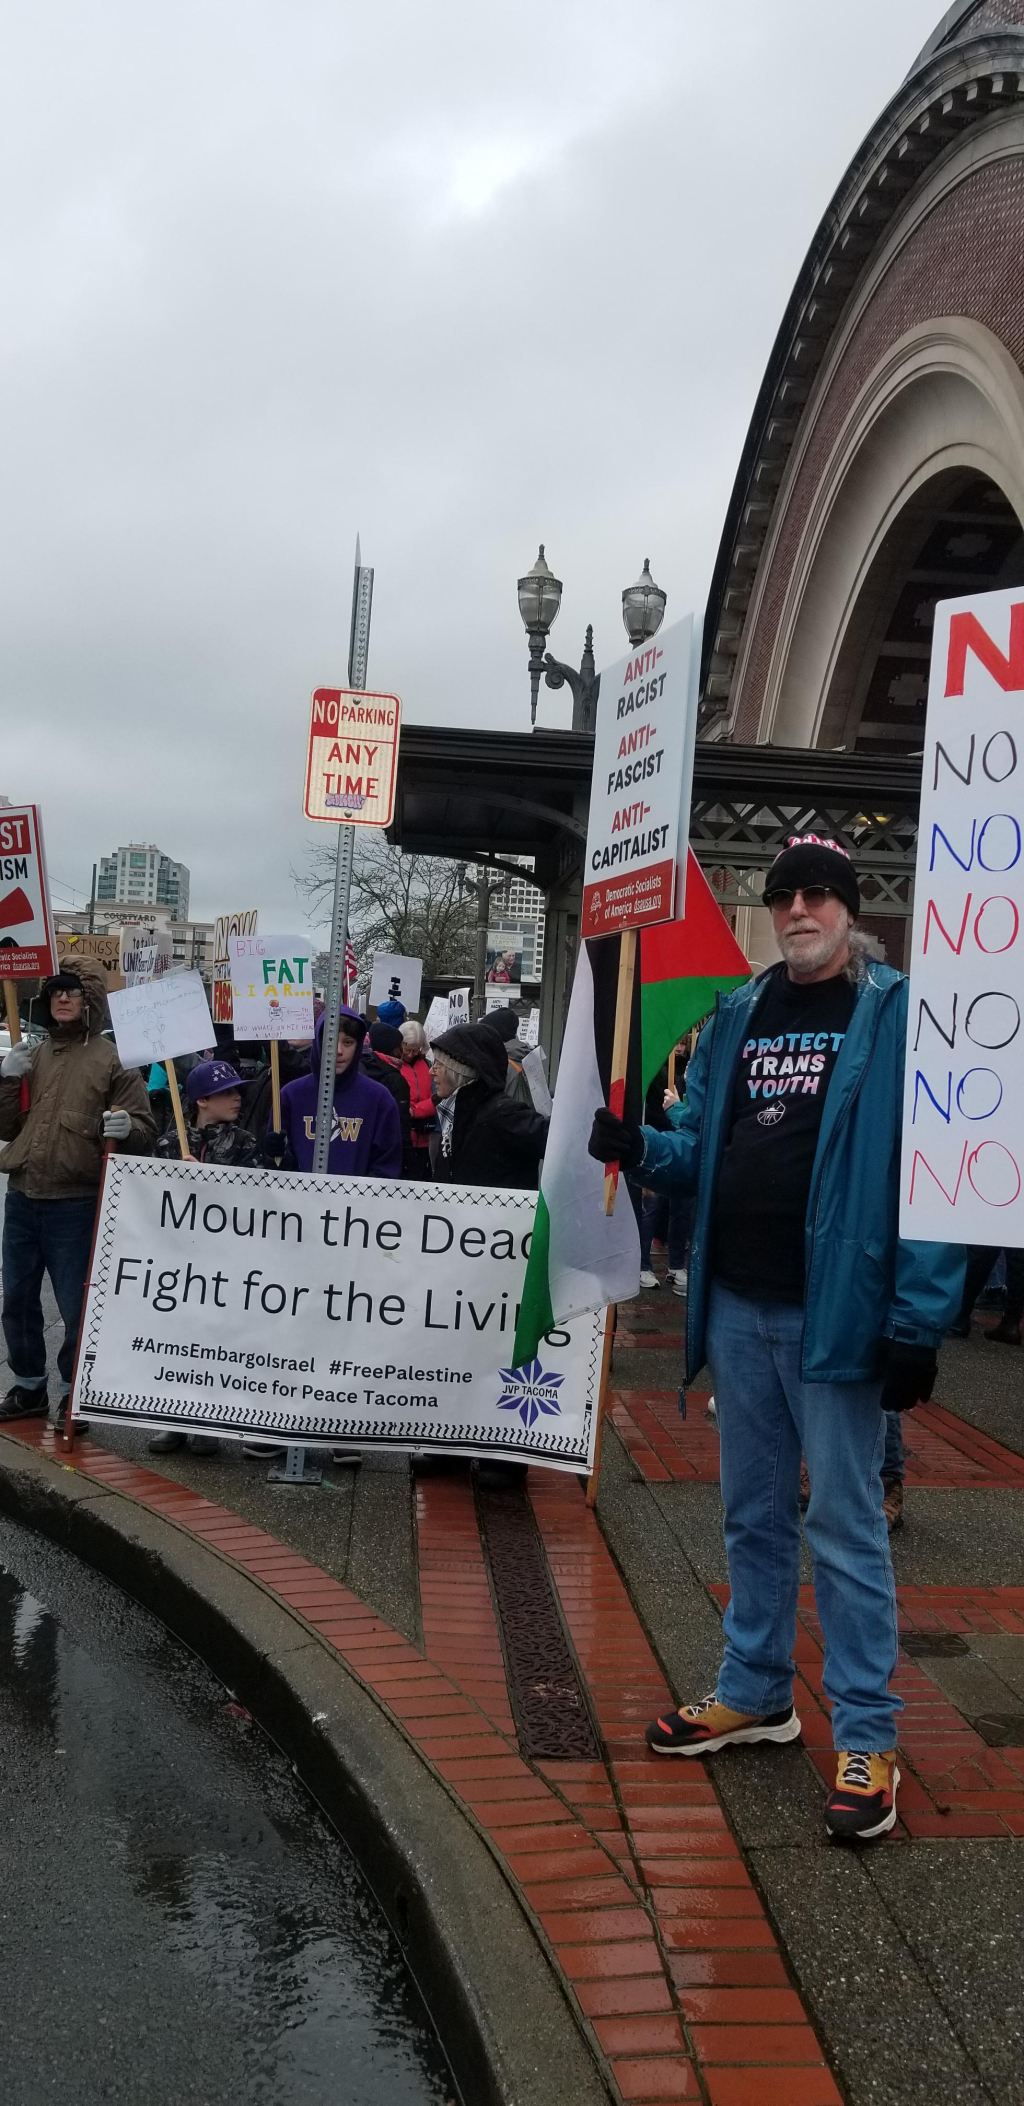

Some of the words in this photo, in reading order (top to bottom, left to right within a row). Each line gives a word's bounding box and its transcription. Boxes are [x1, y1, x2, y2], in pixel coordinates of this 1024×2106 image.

[623, 646, 664, 686] ANTI-
[313, 699, 339, 725] NO
[341, 706, 394, 726] PARKING
[616, 672, 667, 720] RACIST
[327, 742, 379, 766] ANY
[617, 723, 657, 760] ANTI-
[607, 749, 664, 795] FASCIST
[933, 731, 1017, 791] NO
[322, 772, 379, 799] TIME
[611, 801, 651, 834] ANTI-
[591, 824, 669, 871] CAPITALIST
[929, 814, 1021, 872] NO
[605, 882, 635, 902] Democratic
[635, 875, 662, 895] Socialists
[604, 905, 611, 919] of
[611, 901, 632, 917] America
[923, 893, 1019, 955] NO
[11, 951, 38, 961] Socialists
[236, 939, 266, 957] BIG
[262, 957, 309, 984] FAT
[450, 993, 464, 1009] NO
[913, 991, 1020, 1052] NO
[742, 1032, 845, 1059] PROTECT
[750, 1054, 826, 1076] TRANS
[747, 1075, 820, 1098] YOUTH
[911, 1067, 1003, 1125] NO
[909, 1140, 1021, 1207] NO
[160, 1190, 303, 1243] Mourn
[320, 1206, 402, 1250] the
[114, 1257, 229, 1312] Fight
[242, 1269, 310, 1316] for
[323, 1280, 406, 1326] the
[131, 1336, 316, 1373] #ArmsEmbargoIsrael
[328, 1359, 473, 1384] #FreePalestine
[153, 1366, 214, 1387] Jewish
[219, 1373, 268, 1394] Voice
[272, 1380, 298, 1398] for
[302, 1384, 358, 1404] Peace
[363, 1389, 439, 1408] Tacoma
[501, 1384, 520, 1395] JVP
[521, 1385, 558, 1400] TACOMA
